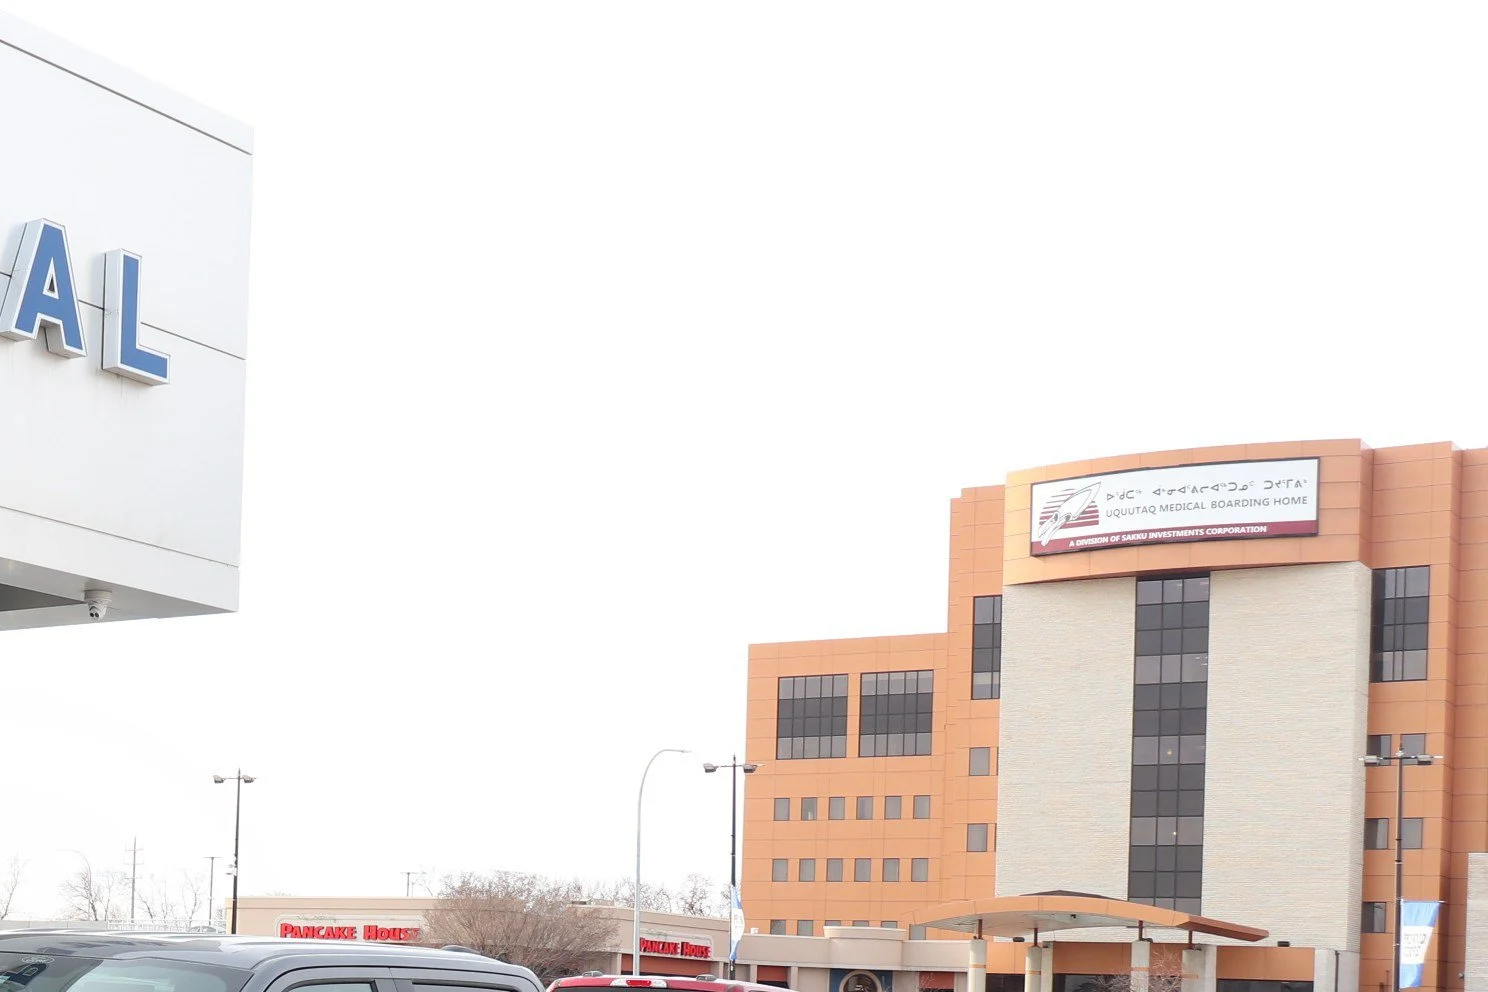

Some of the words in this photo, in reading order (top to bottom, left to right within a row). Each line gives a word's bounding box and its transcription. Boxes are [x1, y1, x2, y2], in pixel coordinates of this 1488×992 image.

[1105, 505, 1157, 518] UQUUTAQ
[1159, 501, 1206, 512] MEDICAL
[1210, 498, 1270, 509] BOARDING
[1273, 495, 1308, 506] HOME
[1075, 536, 1109, 546] DIVISION
[1110, 534, 1120, 542] OF
[1121, 532, 1147, 541] SAKKU
[1148, 529, 1204, 539] INVESTMENTS
[1205, 525, 1268, 535] CORPORATION
[280, 922, 358, 939] PANCAKE
[639, 937, 681, 955] PANCAKE
[680, 942, 711, 958] HOUSE
